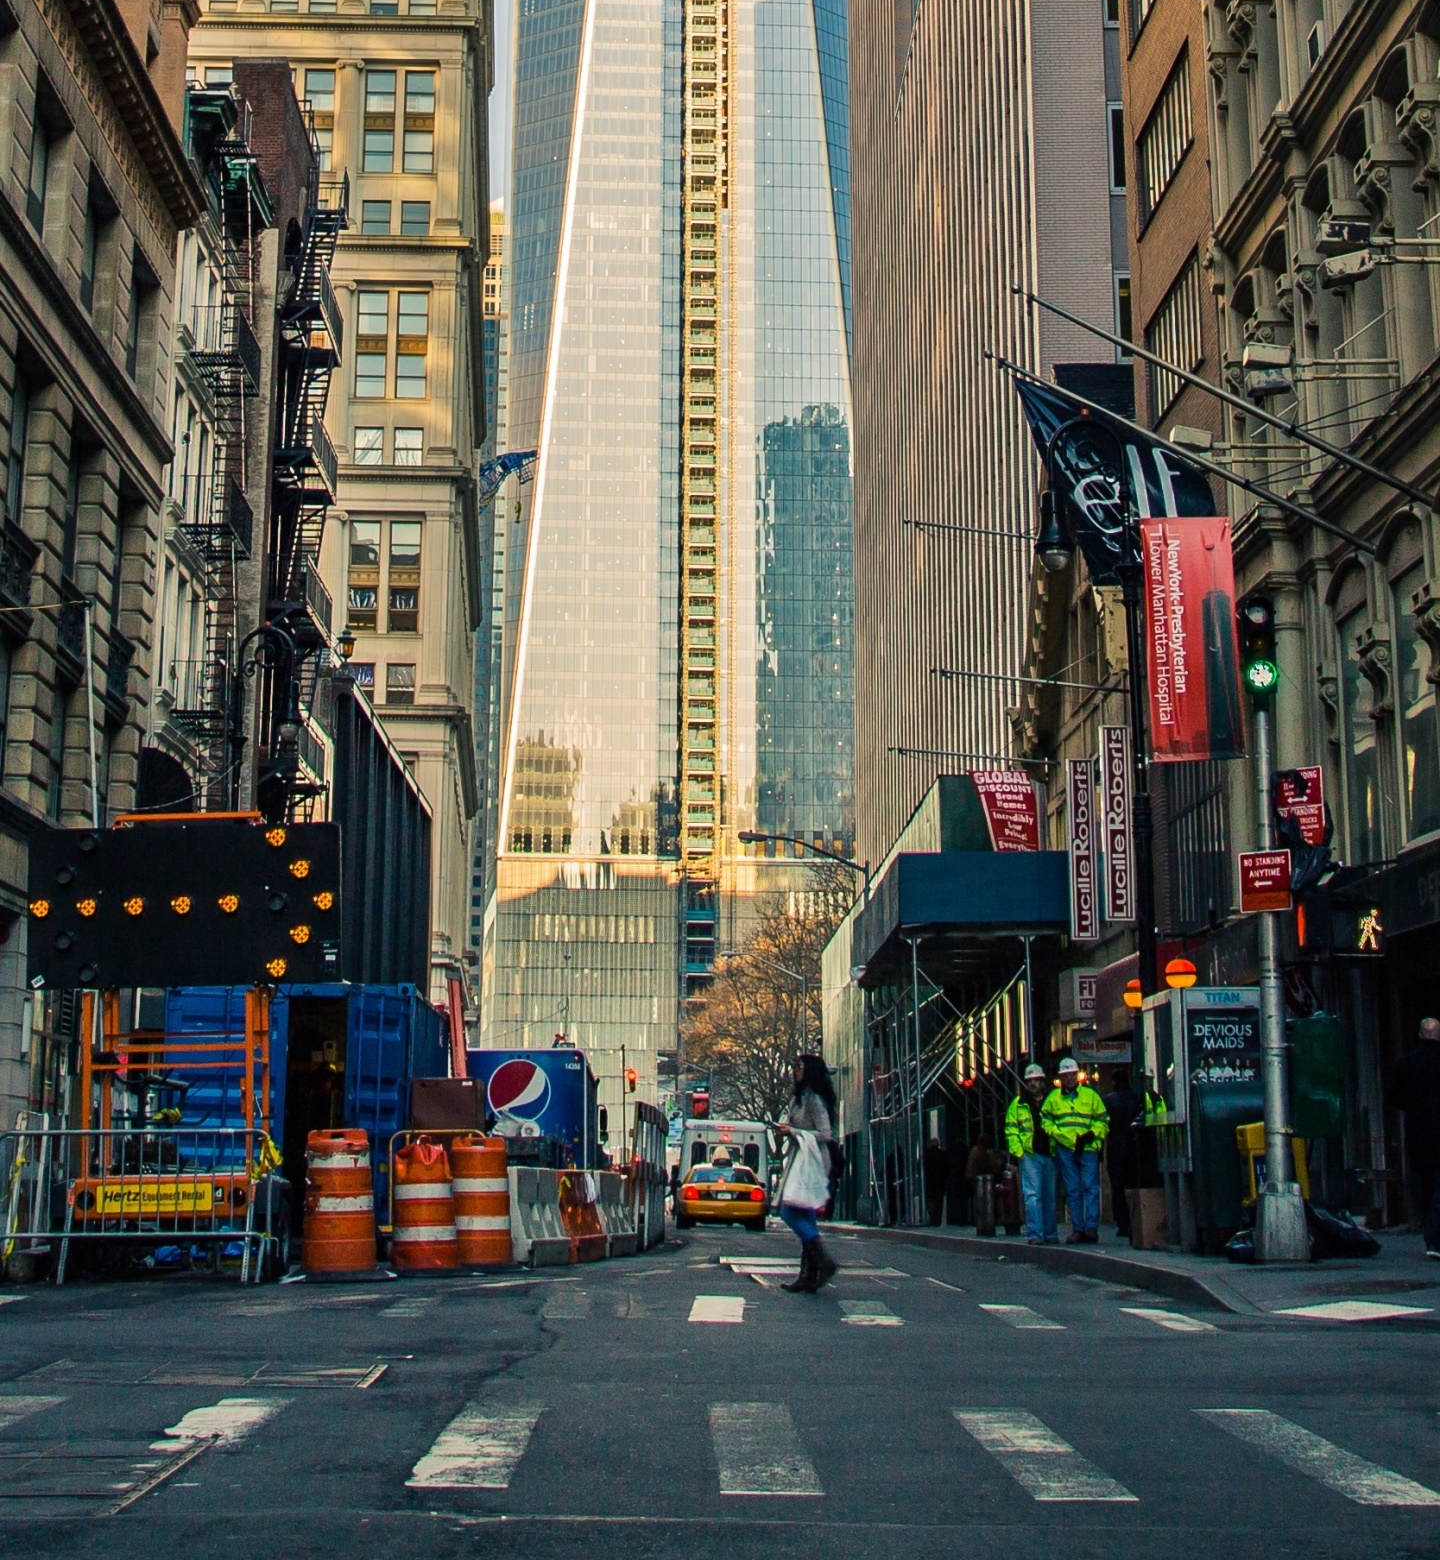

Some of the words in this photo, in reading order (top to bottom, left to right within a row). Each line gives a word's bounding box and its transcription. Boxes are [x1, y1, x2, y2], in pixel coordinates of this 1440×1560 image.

[1149, 542, 1163, 582] Lower
[1151, 582, 1168, 664] Manhattan
[1167, 539, 1187, 694] NewYork-Presbyterian
[1157, 666, 1175, 725] Hospital
[973, 771, 1030, 785] GLOBAL
[1107, 728, 1125, 830] Roberts
[978, 784, 1032, 794] DISCOUNT
[995, 792, 1024, 801] Brand
[996, 801, 1027, 810] Names
[1073, 761, 1089, 856] Roberts
[1243, 858, 1253, 867] NO
[1254, 855, 1286, 866] STANDING
[1113, 834, 1127, 918] Lucille
[1249, 868, 1281, 879] ANYTIME
[1077, 859, 1092, 937] Lucille
[1079, 980, 1096, 997] FI
[1204, 992, 1241, 1003] TITAN
[1193, 1024, 1253, 1038] DEVIOUS
[1203, 1037, 1245, 1050] MAIDS
[104, 1190, 141, 1203] Hertz
[142, 1191, 180, 1203] Equpment
